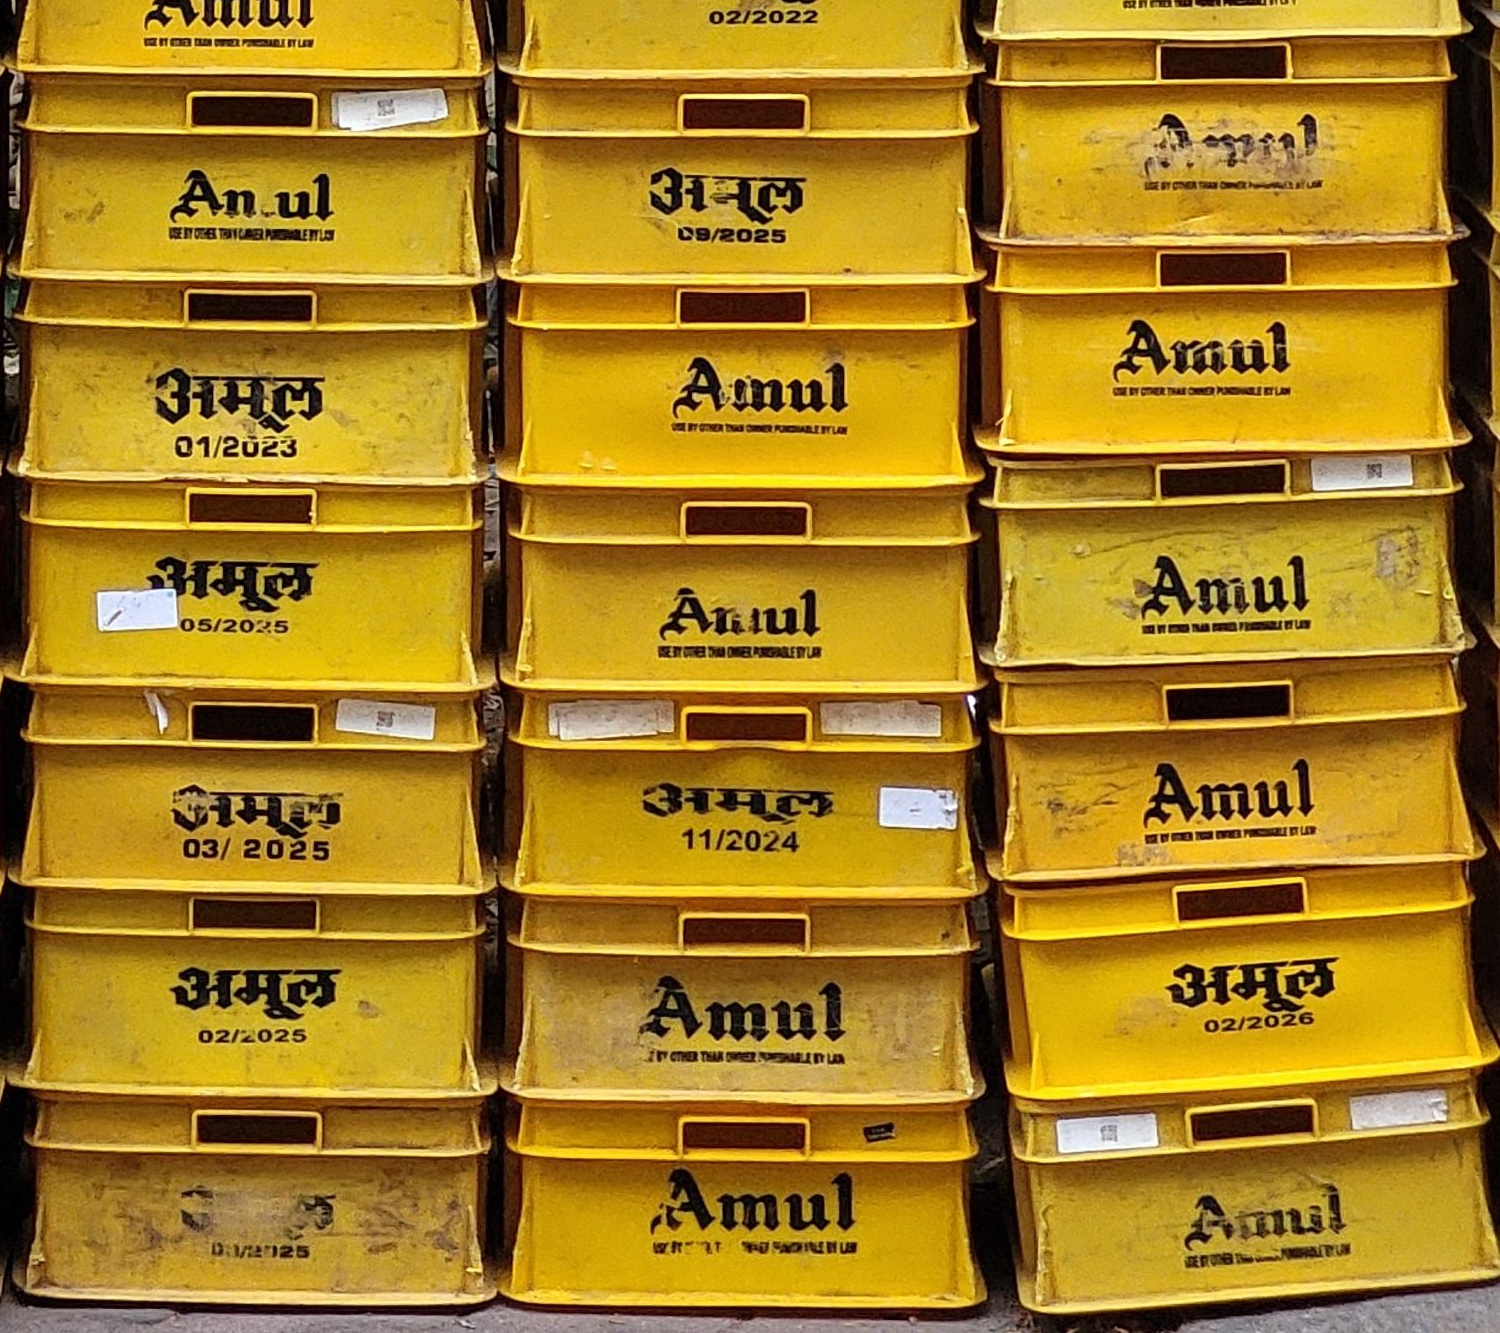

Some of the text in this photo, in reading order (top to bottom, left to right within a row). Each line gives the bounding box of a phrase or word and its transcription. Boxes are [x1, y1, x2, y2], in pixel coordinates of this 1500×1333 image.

[709, 9, 818, 24] 02/2022
[1113, 318, 1290, 382] Amul
[155, 367, 324, 429] अमूल
[673, 356, 848, 417] Amul
[175, 435, 298, 459] 01/2023
[146, 557, 320, 609] अमूल
[1142, 554, 1309, 619] Amul
[180, 618, 288, 634] 05/2025
[643, 781, 833, 826] अमूल
[1143, 757, 1315, 825] Amul
[243, 839, 330, 862] 2025
[681, 829, 799, 853] 11/2024
[169, 966, 341, 1020] अमूल
[641, 974, 845, 1042] Amul
[1165, 956, 1339, 1011] अमूल
[1204, 1011, 1314, 1033] 02/2026
[651, 1167, 855, 1233] Amul
